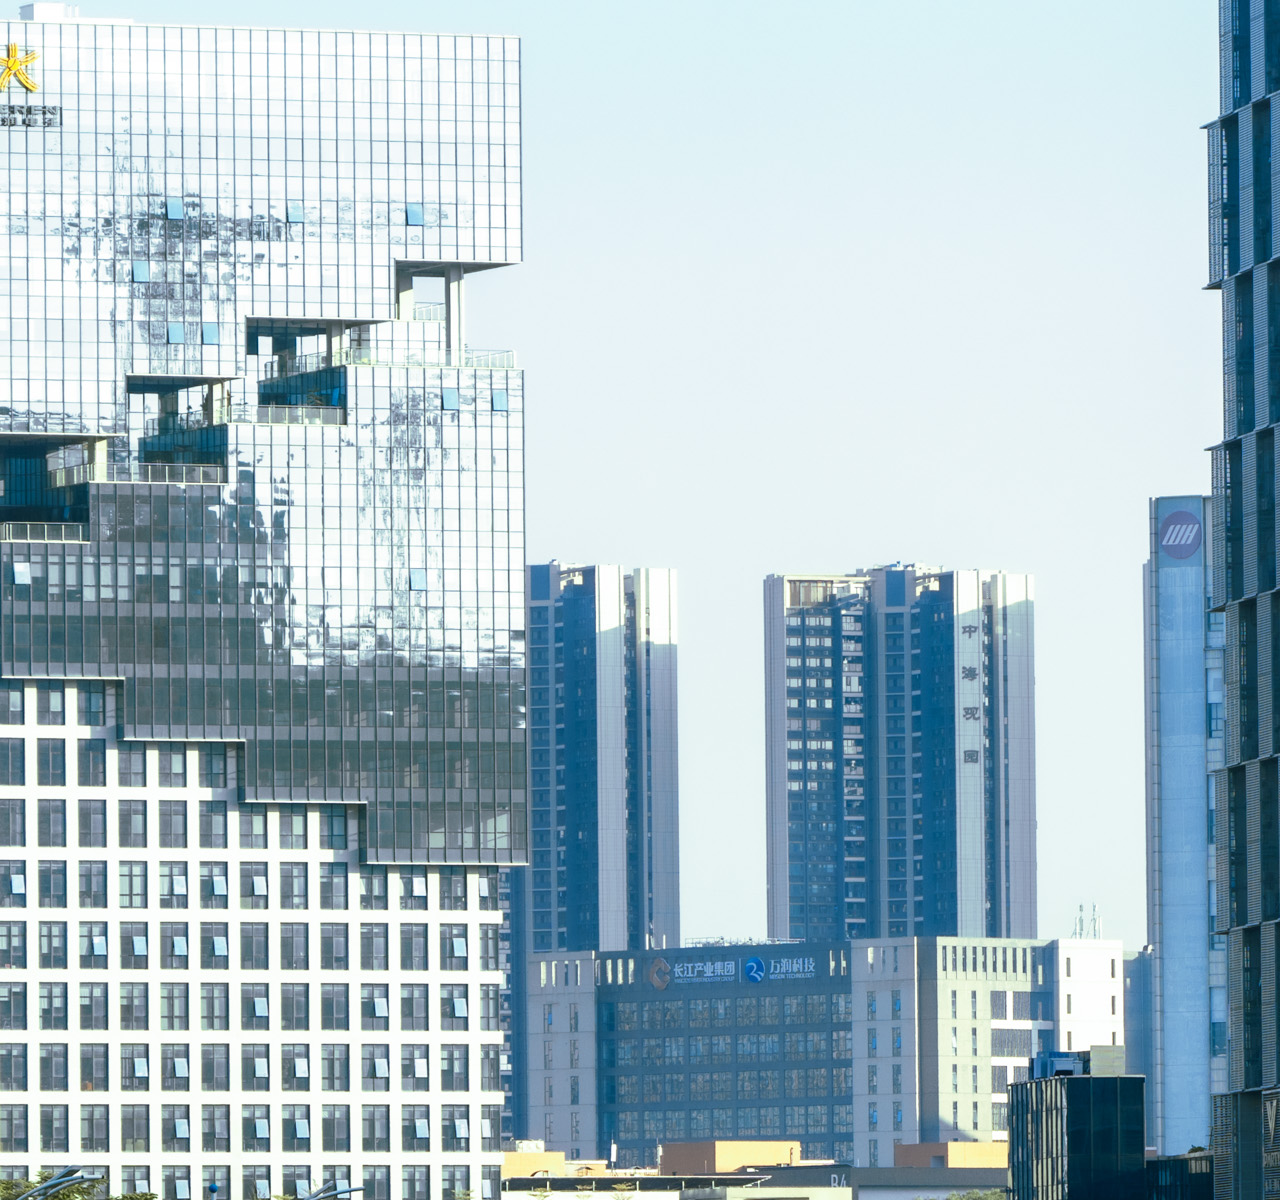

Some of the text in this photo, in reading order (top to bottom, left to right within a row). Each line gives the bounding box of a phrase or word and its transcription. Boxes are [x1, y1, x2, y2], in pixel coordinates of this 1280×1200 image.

[674, 961, 735, 977] 长江产业集团
[770, 957, 816, 973] 万润科技
